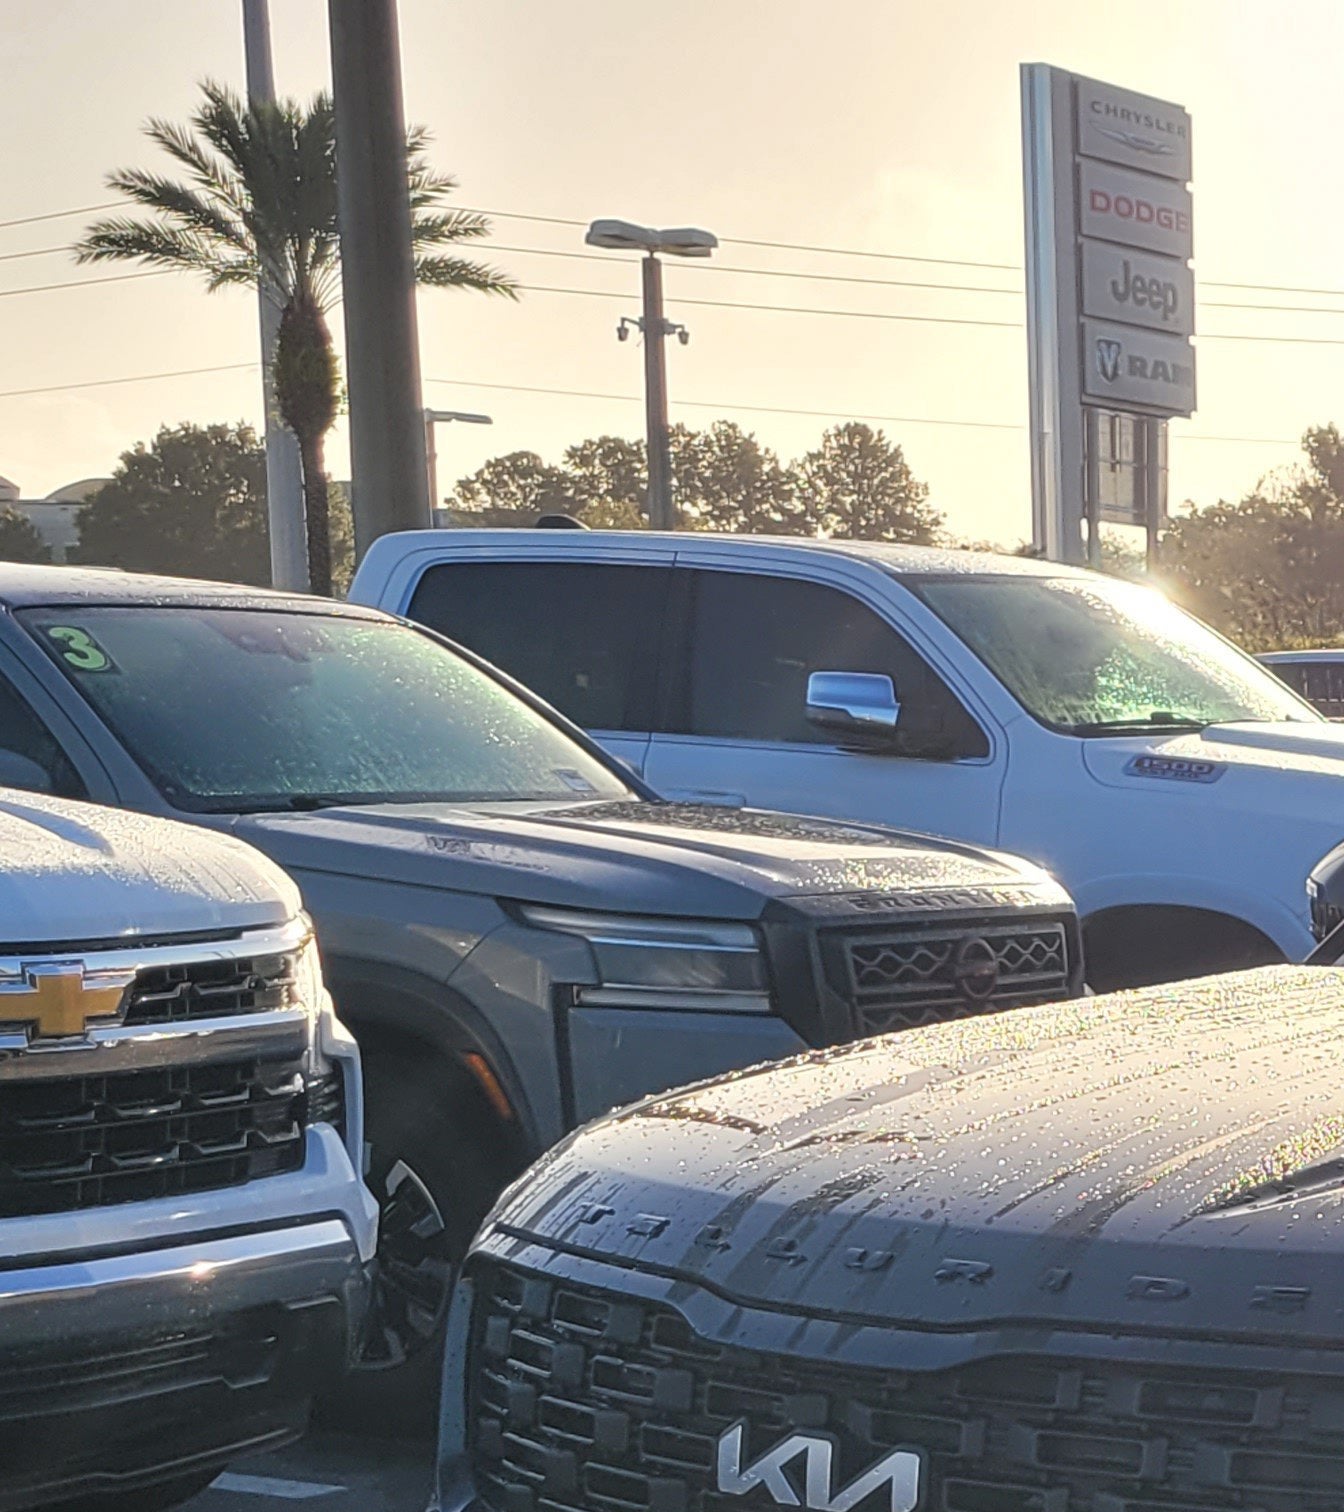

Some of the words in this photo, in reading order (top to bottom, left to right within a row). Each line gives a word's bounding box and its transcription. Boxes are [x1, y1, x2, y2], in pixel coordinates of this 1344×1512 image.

[1091, 101, 1186, 138] CHRYSLER
[1089, 189, 1190, 233] DODGE
[1110, 259, 1178, 320] Jeep
[1127, 355, 1192, 387] RAM
[48, 626, 106, 670] 3
[1141, 757, 1215, 774] 1500
[576, 1201, 1313, 1313] TELLURIDE
